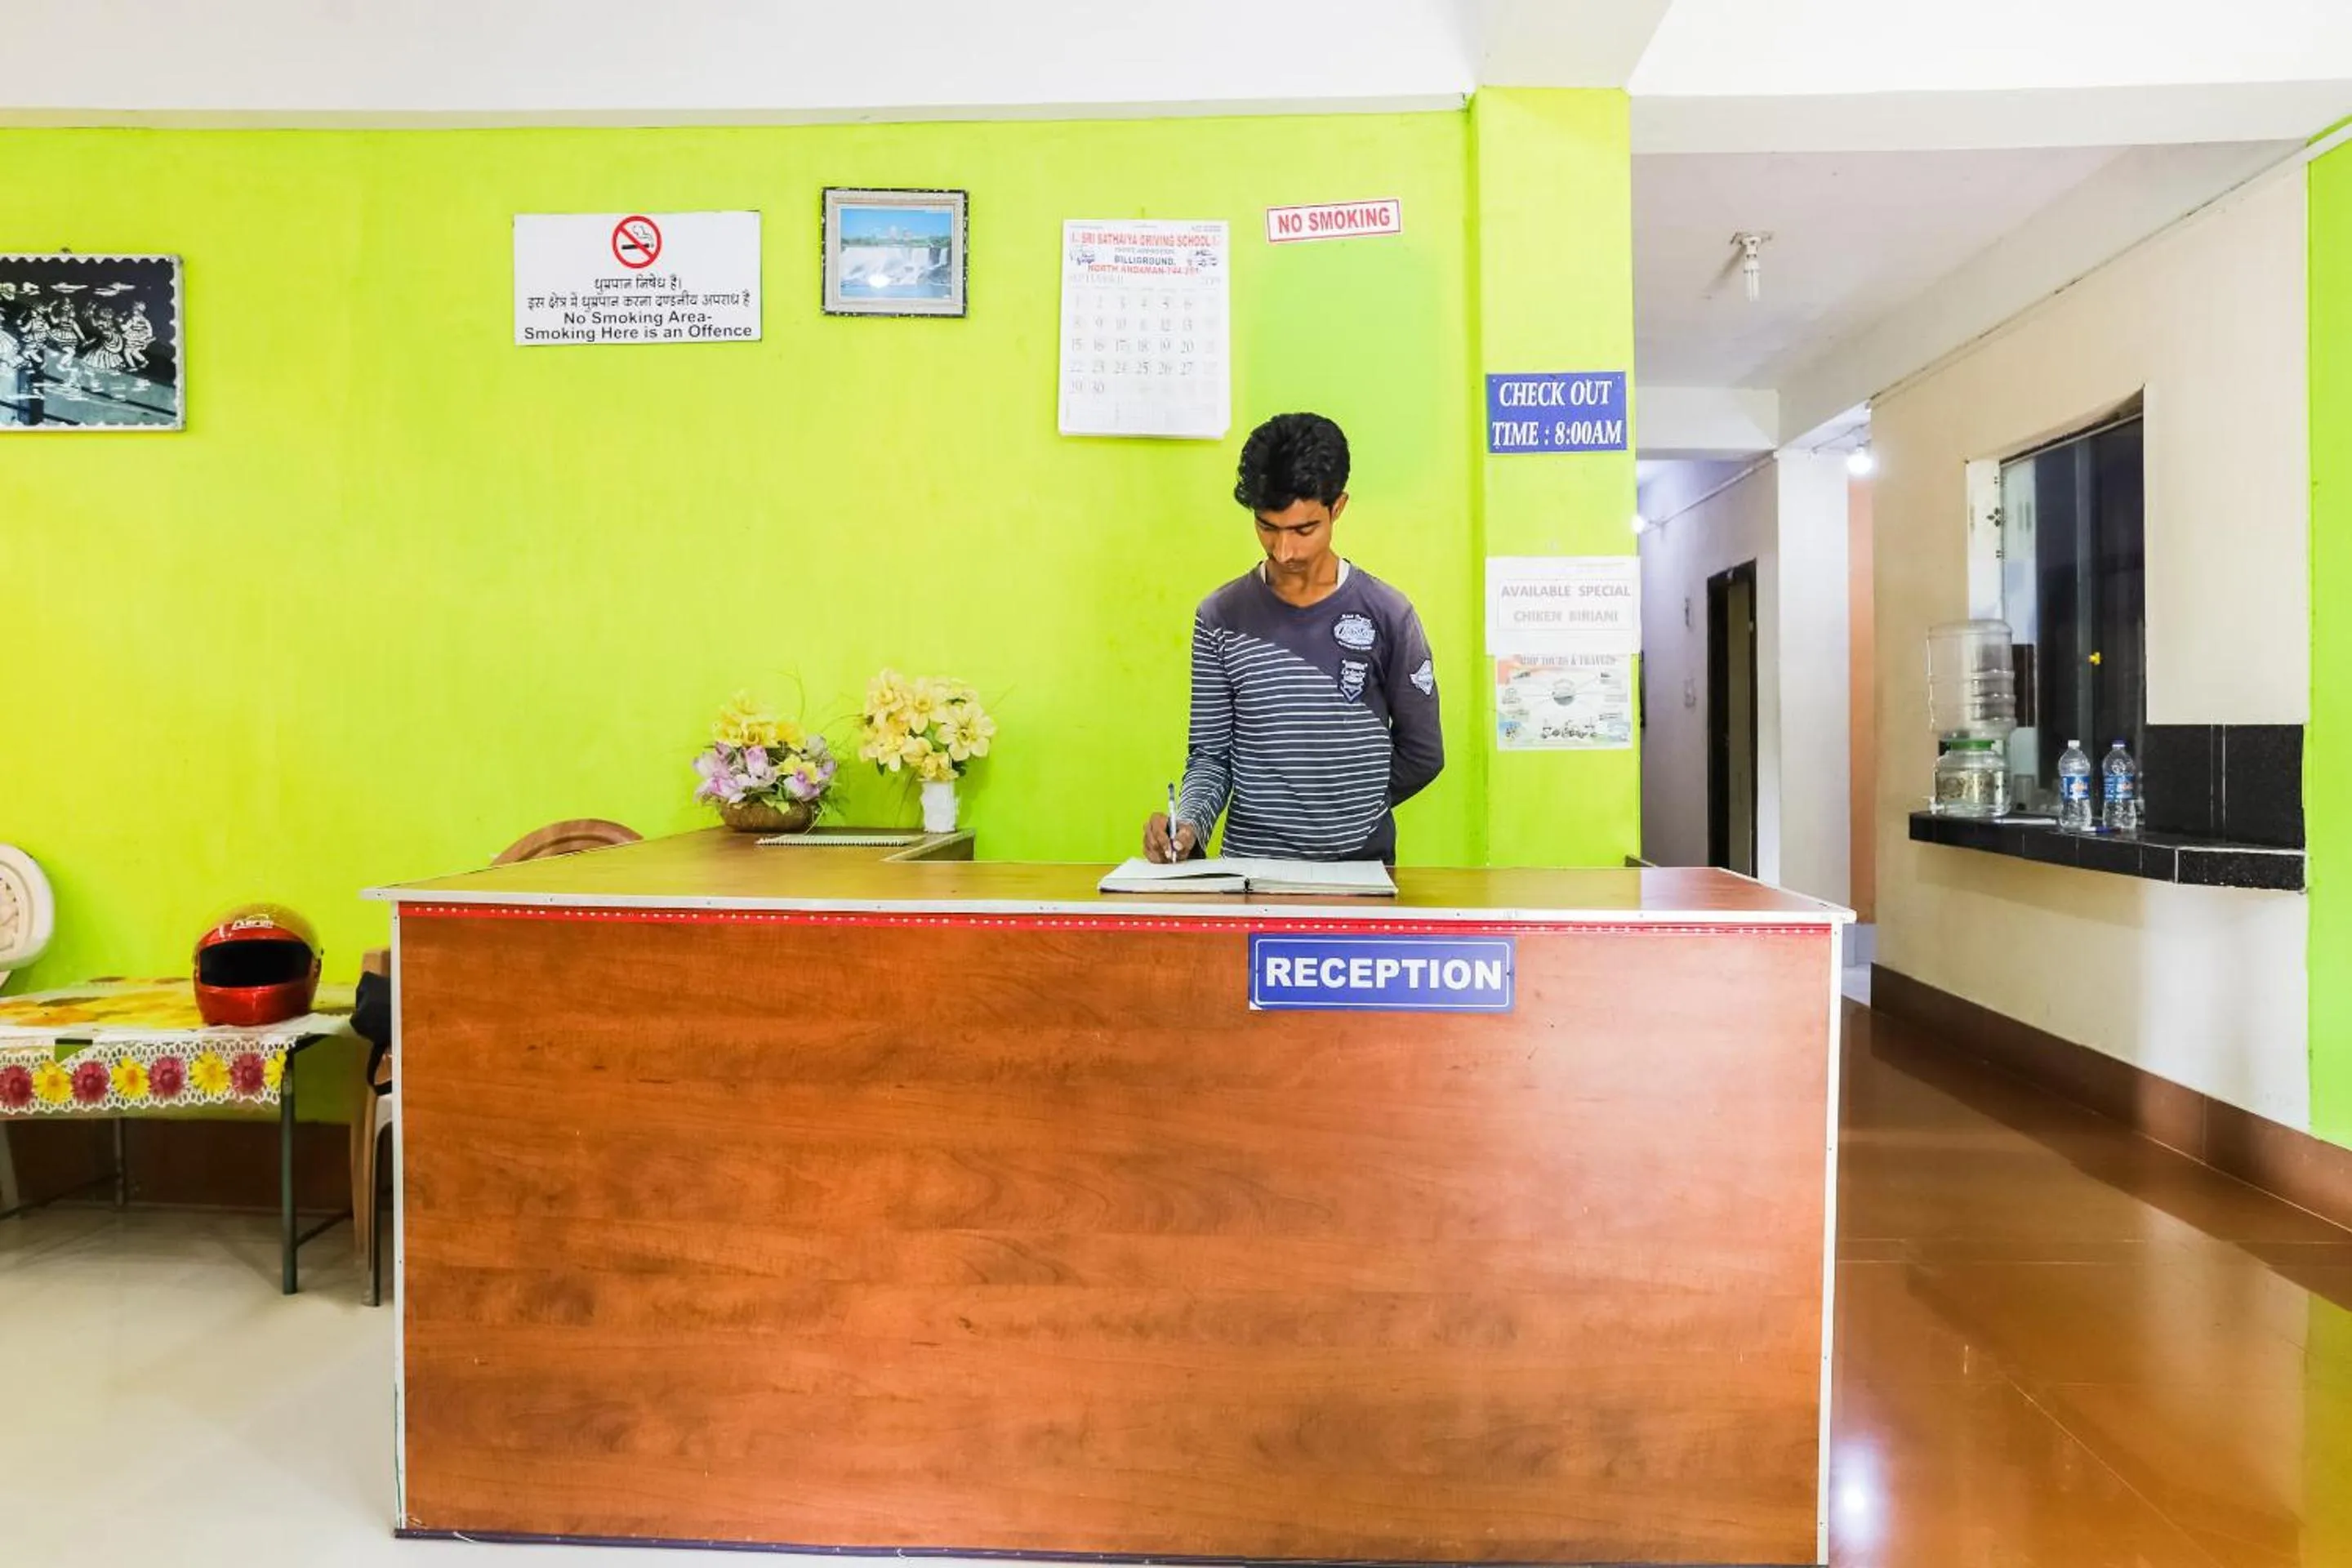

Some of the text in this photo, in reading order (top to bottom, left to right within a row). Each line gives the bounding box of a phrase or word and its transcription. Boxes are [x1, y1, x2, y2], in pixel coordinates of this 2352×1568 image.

[1278, 207, 1390, 234] NO SMOKING
[1140, 234, 1174, 247] DRIVING
[1176, 234, 1211, 247] SCHOOL
[1088, 264, 1118, 274] NORTH
[528, 297, 545, 310] इस
[564, 312, 586, 325] No
[591, 310, 663, 327] Smoking
[524, 323, 752, 342] Smoking Here is an Offence
[1499, 380, 1612, 407] CHECK OUT
[1492, 421, 1539, 447] TIME
[1555, 420, 1623, 445] 8:00AM
[1501, 586, 1631, 597] AVAILABLE SPECIAL
[1266, 957, 1502, 991] RECEPTION
